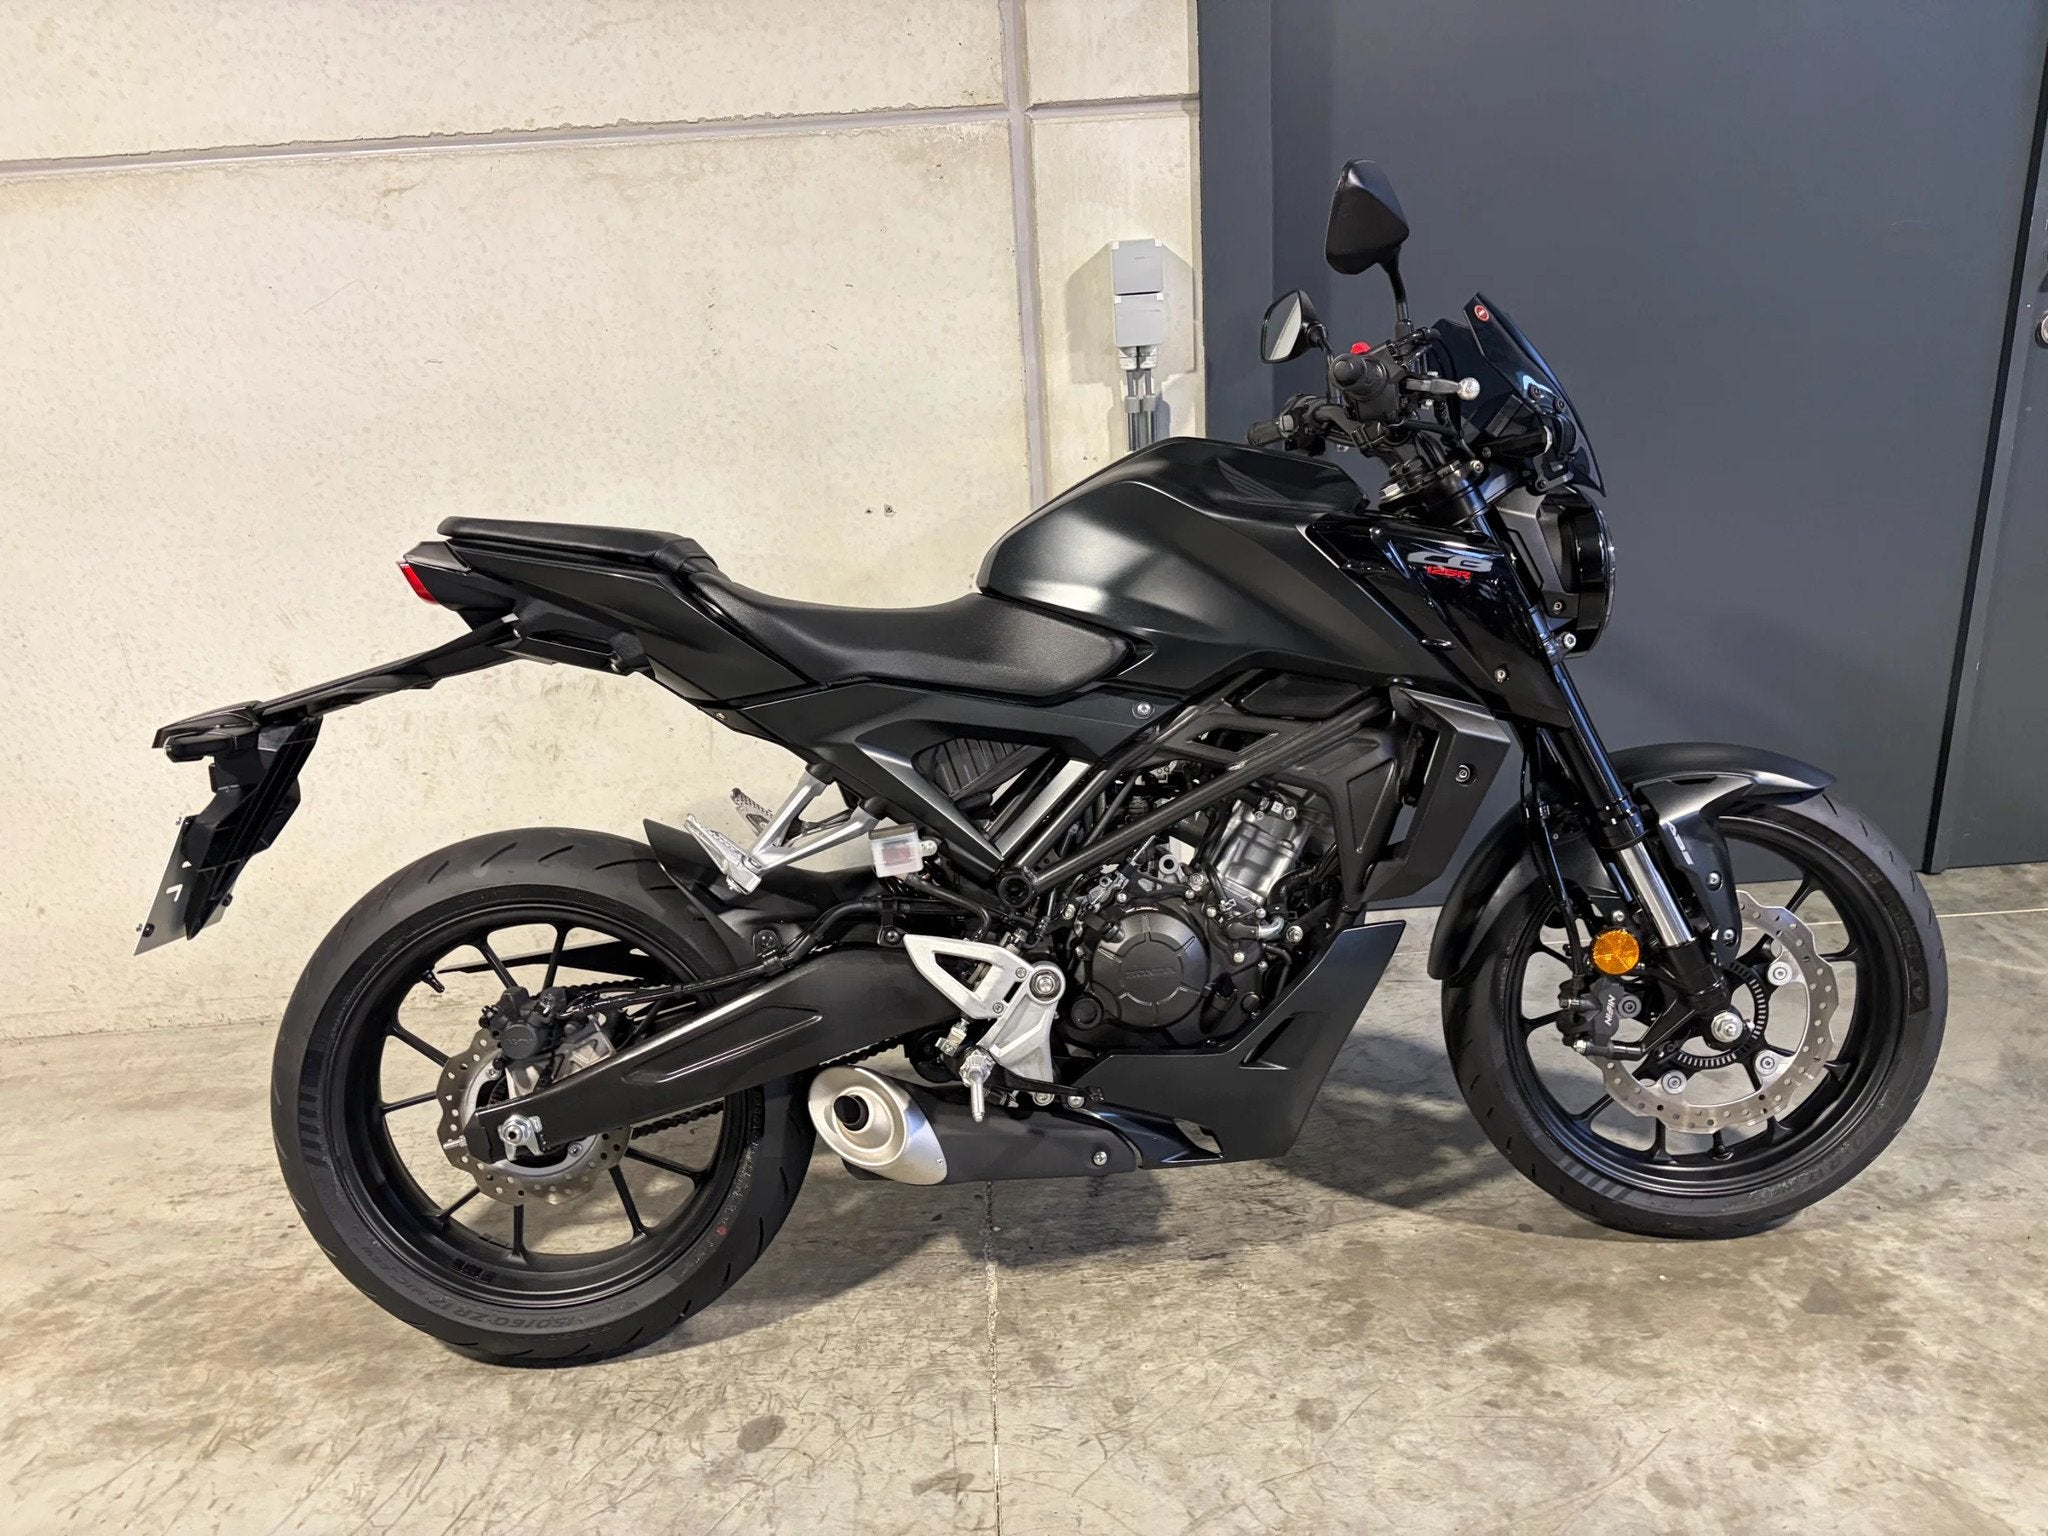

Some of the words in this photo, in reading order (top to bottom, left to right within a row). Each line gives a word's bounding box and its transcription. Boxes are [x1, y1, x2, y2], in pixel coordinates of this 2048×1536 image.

[1407, 551, 1493, 572] CB
[1426, 565, 1471, 579] 125R
[1123, 967, 1177, 979] HONDA
